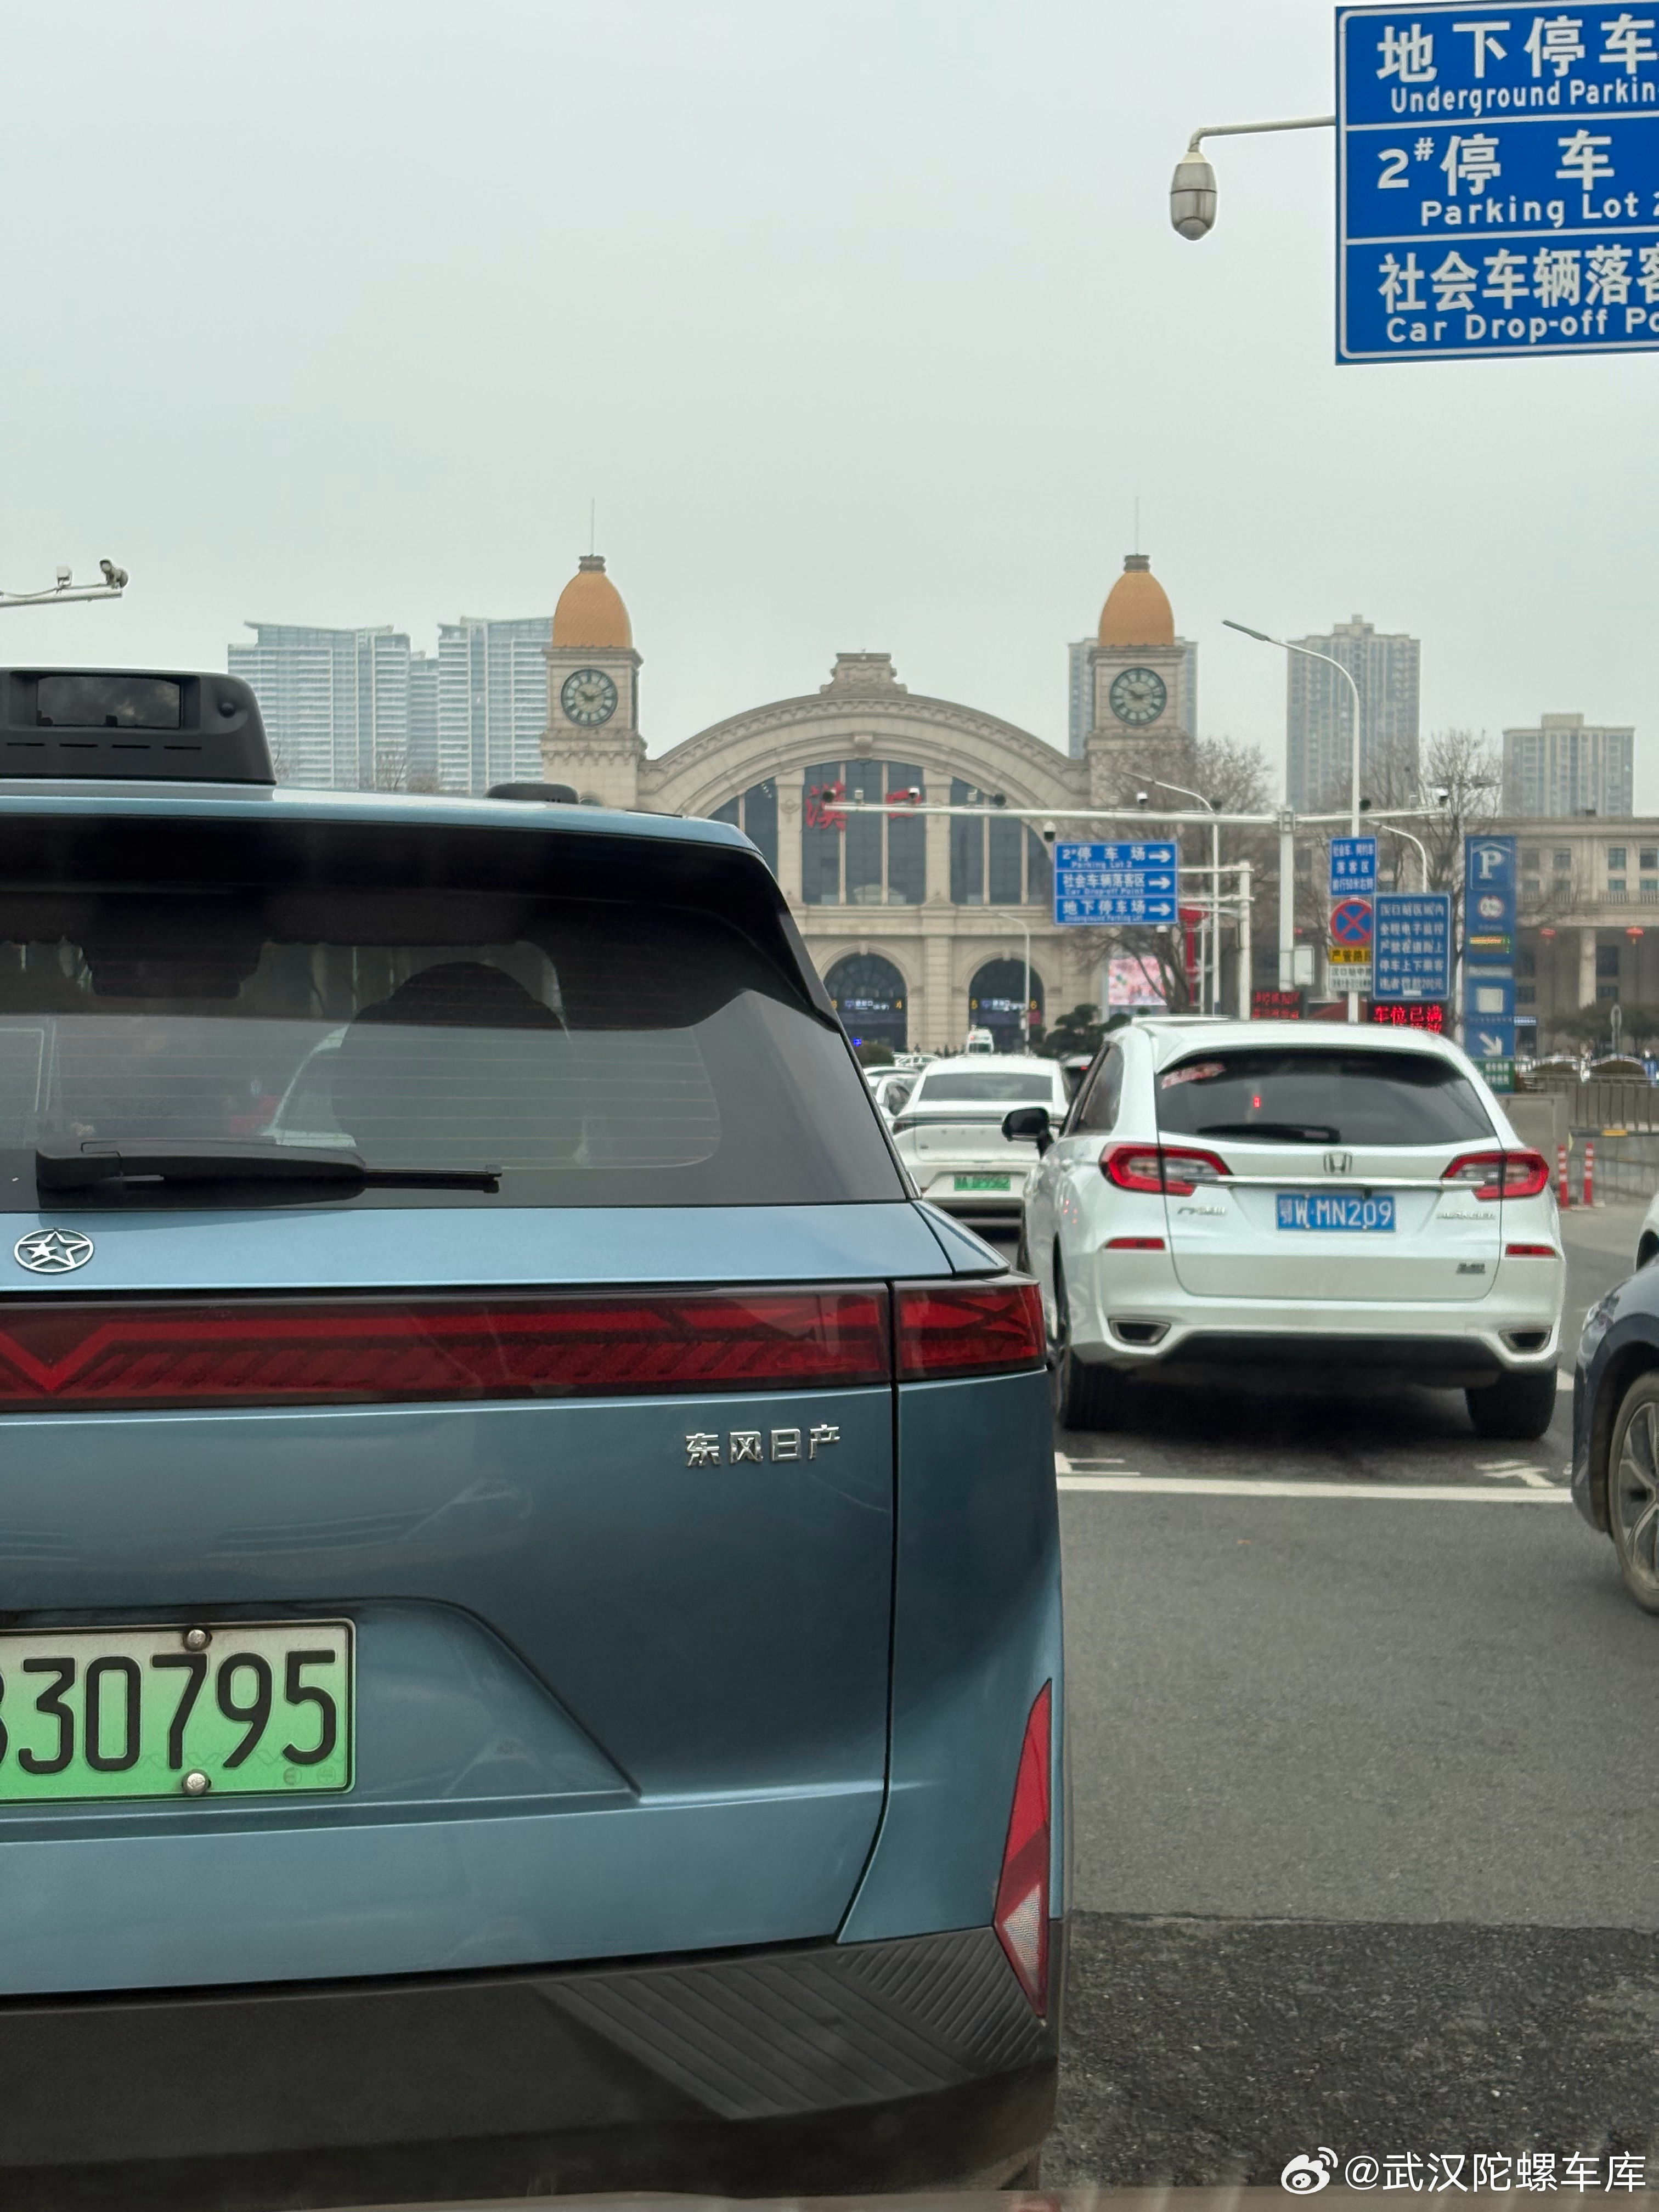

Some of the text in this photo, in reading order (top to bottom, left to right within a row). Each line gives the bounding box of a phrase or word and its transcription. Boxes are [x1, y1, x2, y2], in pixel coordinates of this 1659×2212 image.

[1376, 13, 1659, 83] 地下停车
[1391, 76, 1659, 117] Underground Parkin
[1421, 196, 1565, 228] Parking
[1582, 192, 1639, 219] Lot
[1386, 316, 1448, 343] Car
[1465, 308, 1608, 343] Drop-off
[1062, 900, 1146, 915] 地下停车场
[686, 1424, 840, 1468] 东风日产
[0, 1649, 337, 1774] 30795
